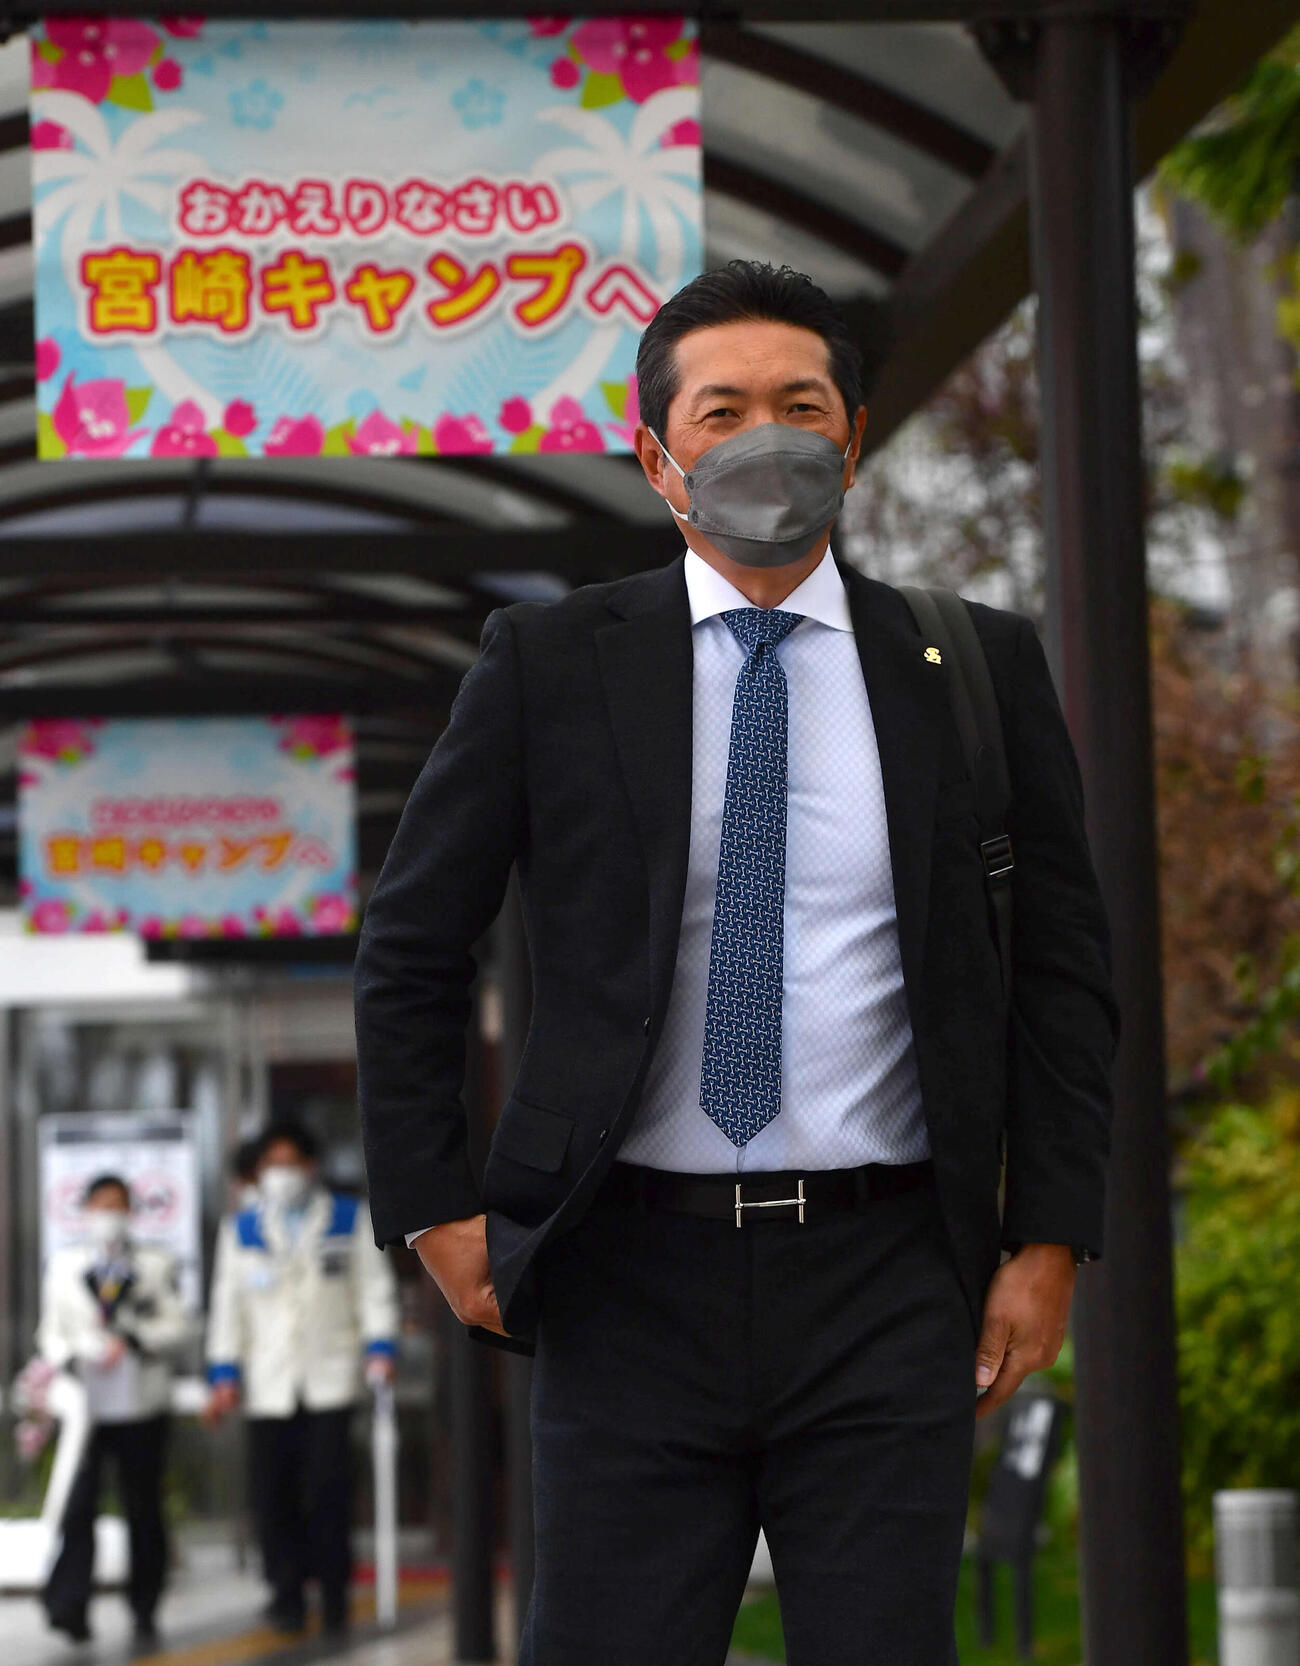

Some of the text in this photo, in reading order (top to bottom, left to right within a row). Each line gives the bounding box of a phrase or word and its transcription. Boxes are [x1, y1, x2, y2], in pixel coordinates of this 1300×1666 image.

[179, 179, 559, 236] おかえりなさい
[80, 243, 661, 335] 宮崎キャンプへ
